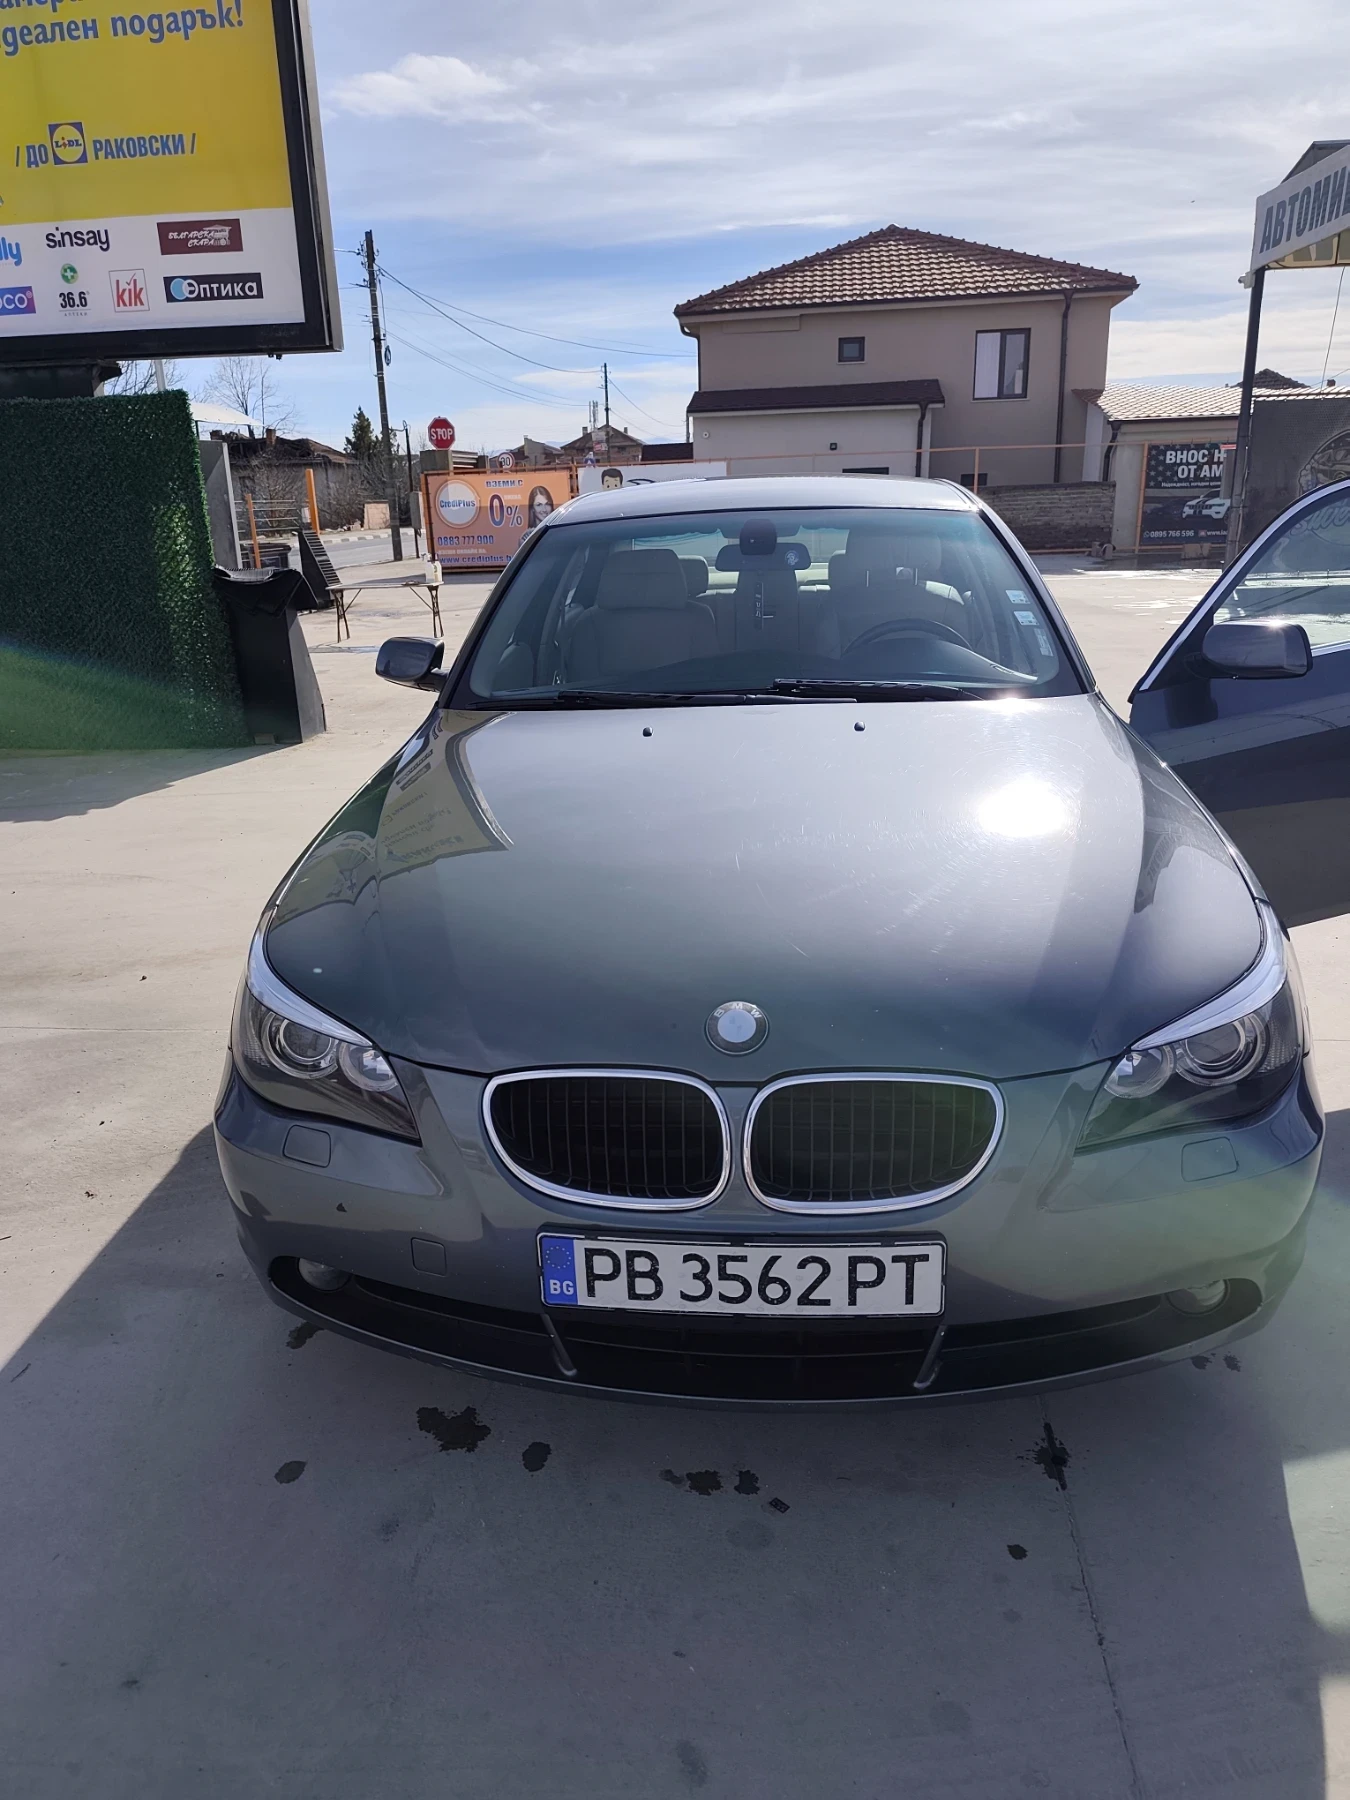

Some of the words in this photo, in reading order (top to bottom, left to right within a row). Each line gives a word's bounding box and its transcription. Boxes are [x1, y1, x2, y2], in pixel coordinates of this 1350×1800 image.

[0, 18, 99, 56] деален
[111, 0, 243, 43] подарък!
[26, 144, 49, 168] ДО
[93, 134, 185, 160] РАКОВСКИ
[45, 227, 110, 252] sinsay
[116, 279, 145, 307] kik
[182, 279, 258, 298] Оптика
[59, 291, 88, 308] 36.6
[430, 428, 453, 440] STOP
[500, 457, 511, 467] 30
[1165, 449, 1208, 464] ВНОС
[1214, 448, 1227, 462] Н
[1177, 465, 1197, 479] ОТ
[489, 494, 523, 527] 0%
[437, 536, 460, 546] 0883
[462, 535, 475, 545] 777
[713, 1002, 763, 1018] BMW
[584, 1247, 664, 1301] PB
[679, 1252, 832, 1306] 3562
[847, 1253, 930, 1306] PT
[549, 1279, 574, 1295] BG
